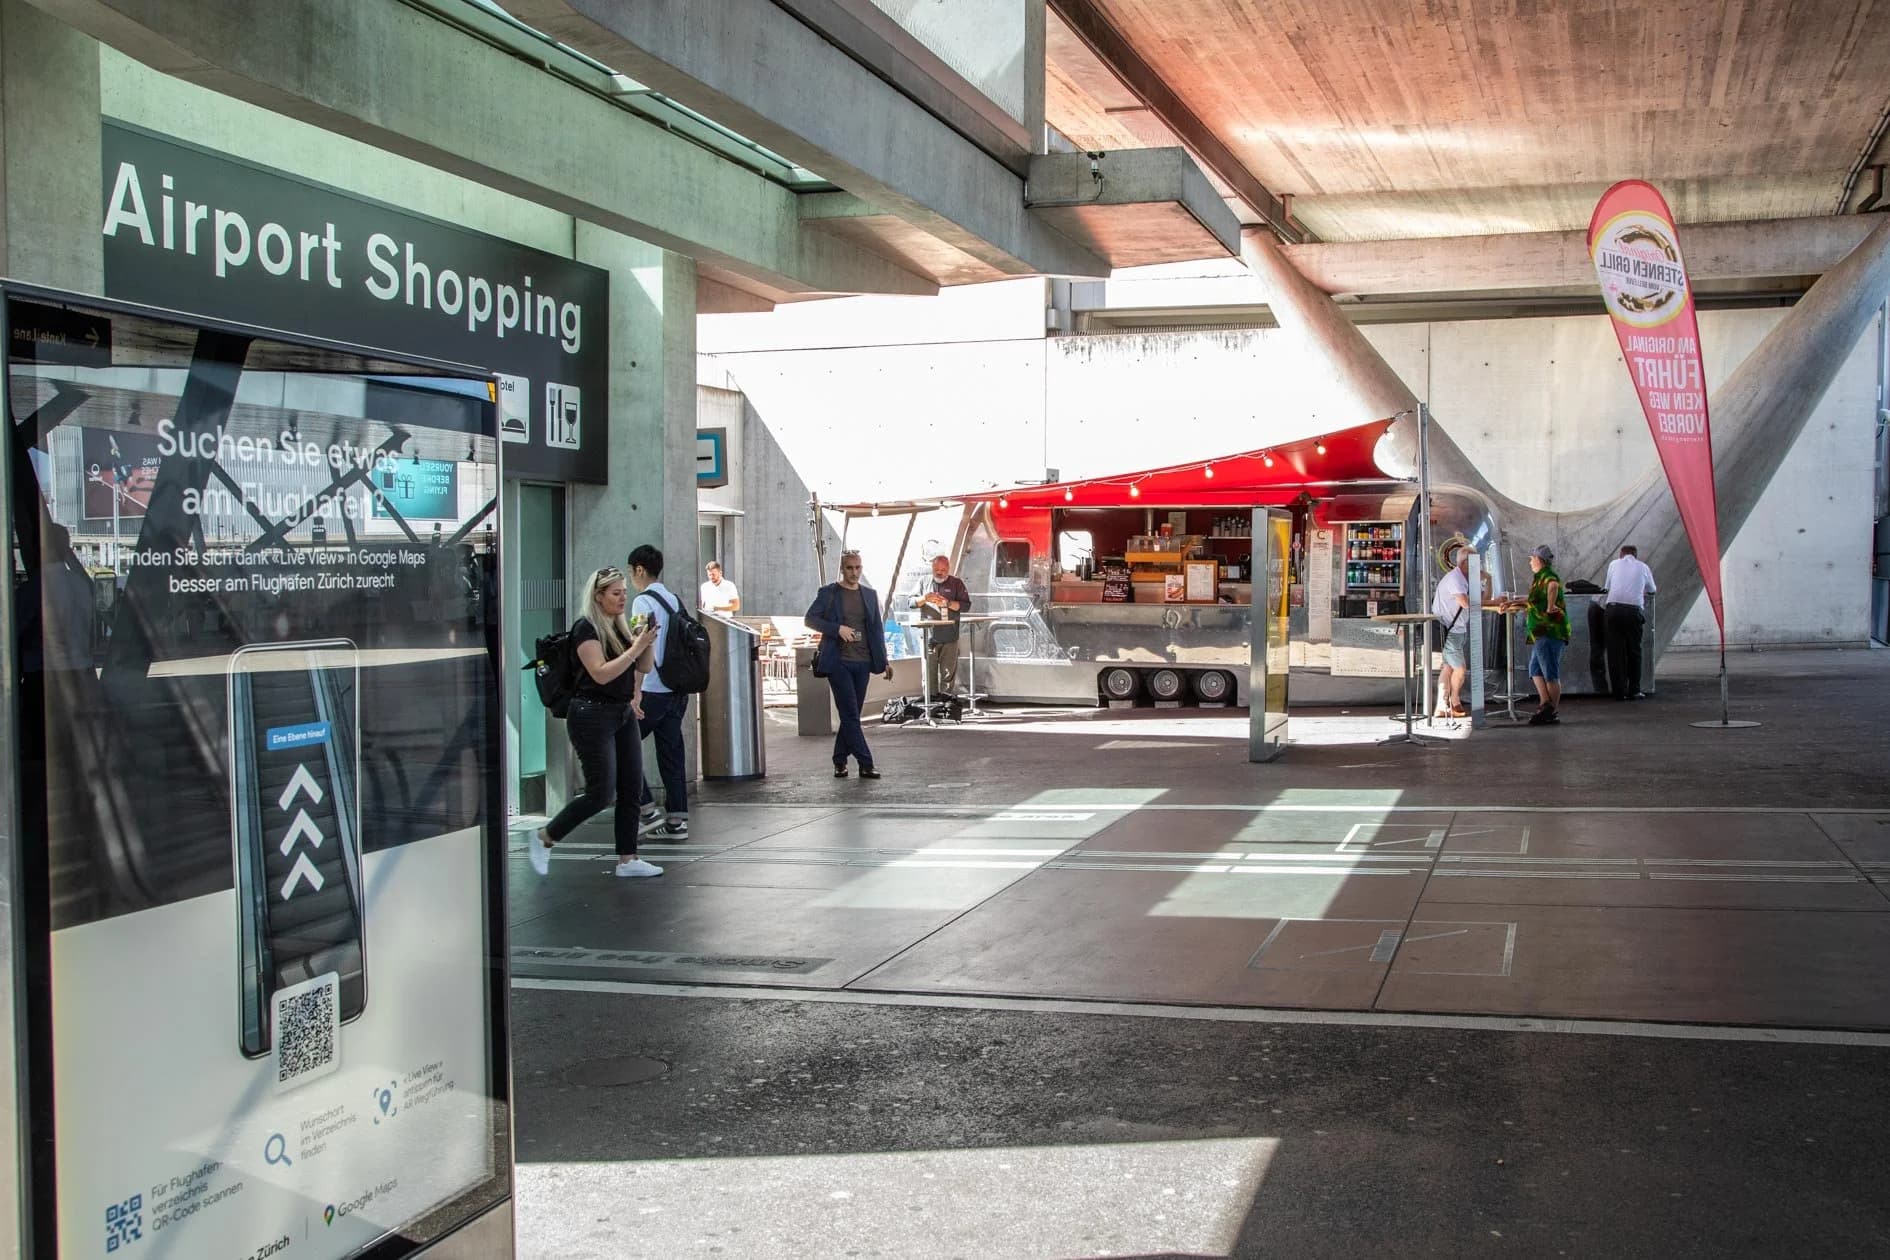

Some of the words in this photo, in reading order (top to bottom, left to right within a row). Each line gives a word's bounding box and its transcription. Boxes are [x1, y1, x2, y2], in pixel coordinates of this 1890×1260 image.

[102, 162, 342, 288] Airport
[365, 232, 581, 354] Shopping
[501, 381, 515, 392] otel
[157, 419, 273, 463] Suchen
[280, 431, 321, 466] Sie
[327, 440, 399, 473] etwas
[182, 486, 230, 515] am
[175, 547, 198, 566] Sie
[202, 547, 232, 566] sich
[235, 547, 268, 566] dank
[272, 548, 305, 565] «Live
[308, 548, 345, 565] View»
[347, 549, 357, 565] in
[359, 549, 397, 569] Google
[399, 549, 425, 568] Maps
[169, 575, 224, 593] besser
[225, 577, 248, 592] am
[251, 573, 314, 595] Flughafen
[317, 572, 354, 589] Zürich
[356, 572, 395, 588] zurecht
[272, 734, 287, 744] Eine
[288, 732, 307, 742] Ebene
[307, 728, 326, 739] hinauf
[673, 956, 807, 969] Smoke
[152, 1184, 168, 1199] Für
[170, 1161, 224, 1190] Flughafen-
[152, 1181, 208, 1214] verzeichnis
[152, 1201, 201, 1231] QR-Code
[203, 1182, 243, 1208] scannen
[338, 1190, 373, 1216] Google
[375, 1179, 398, 1198] Maps
[257, 1235, 290, 1260] Zürich
